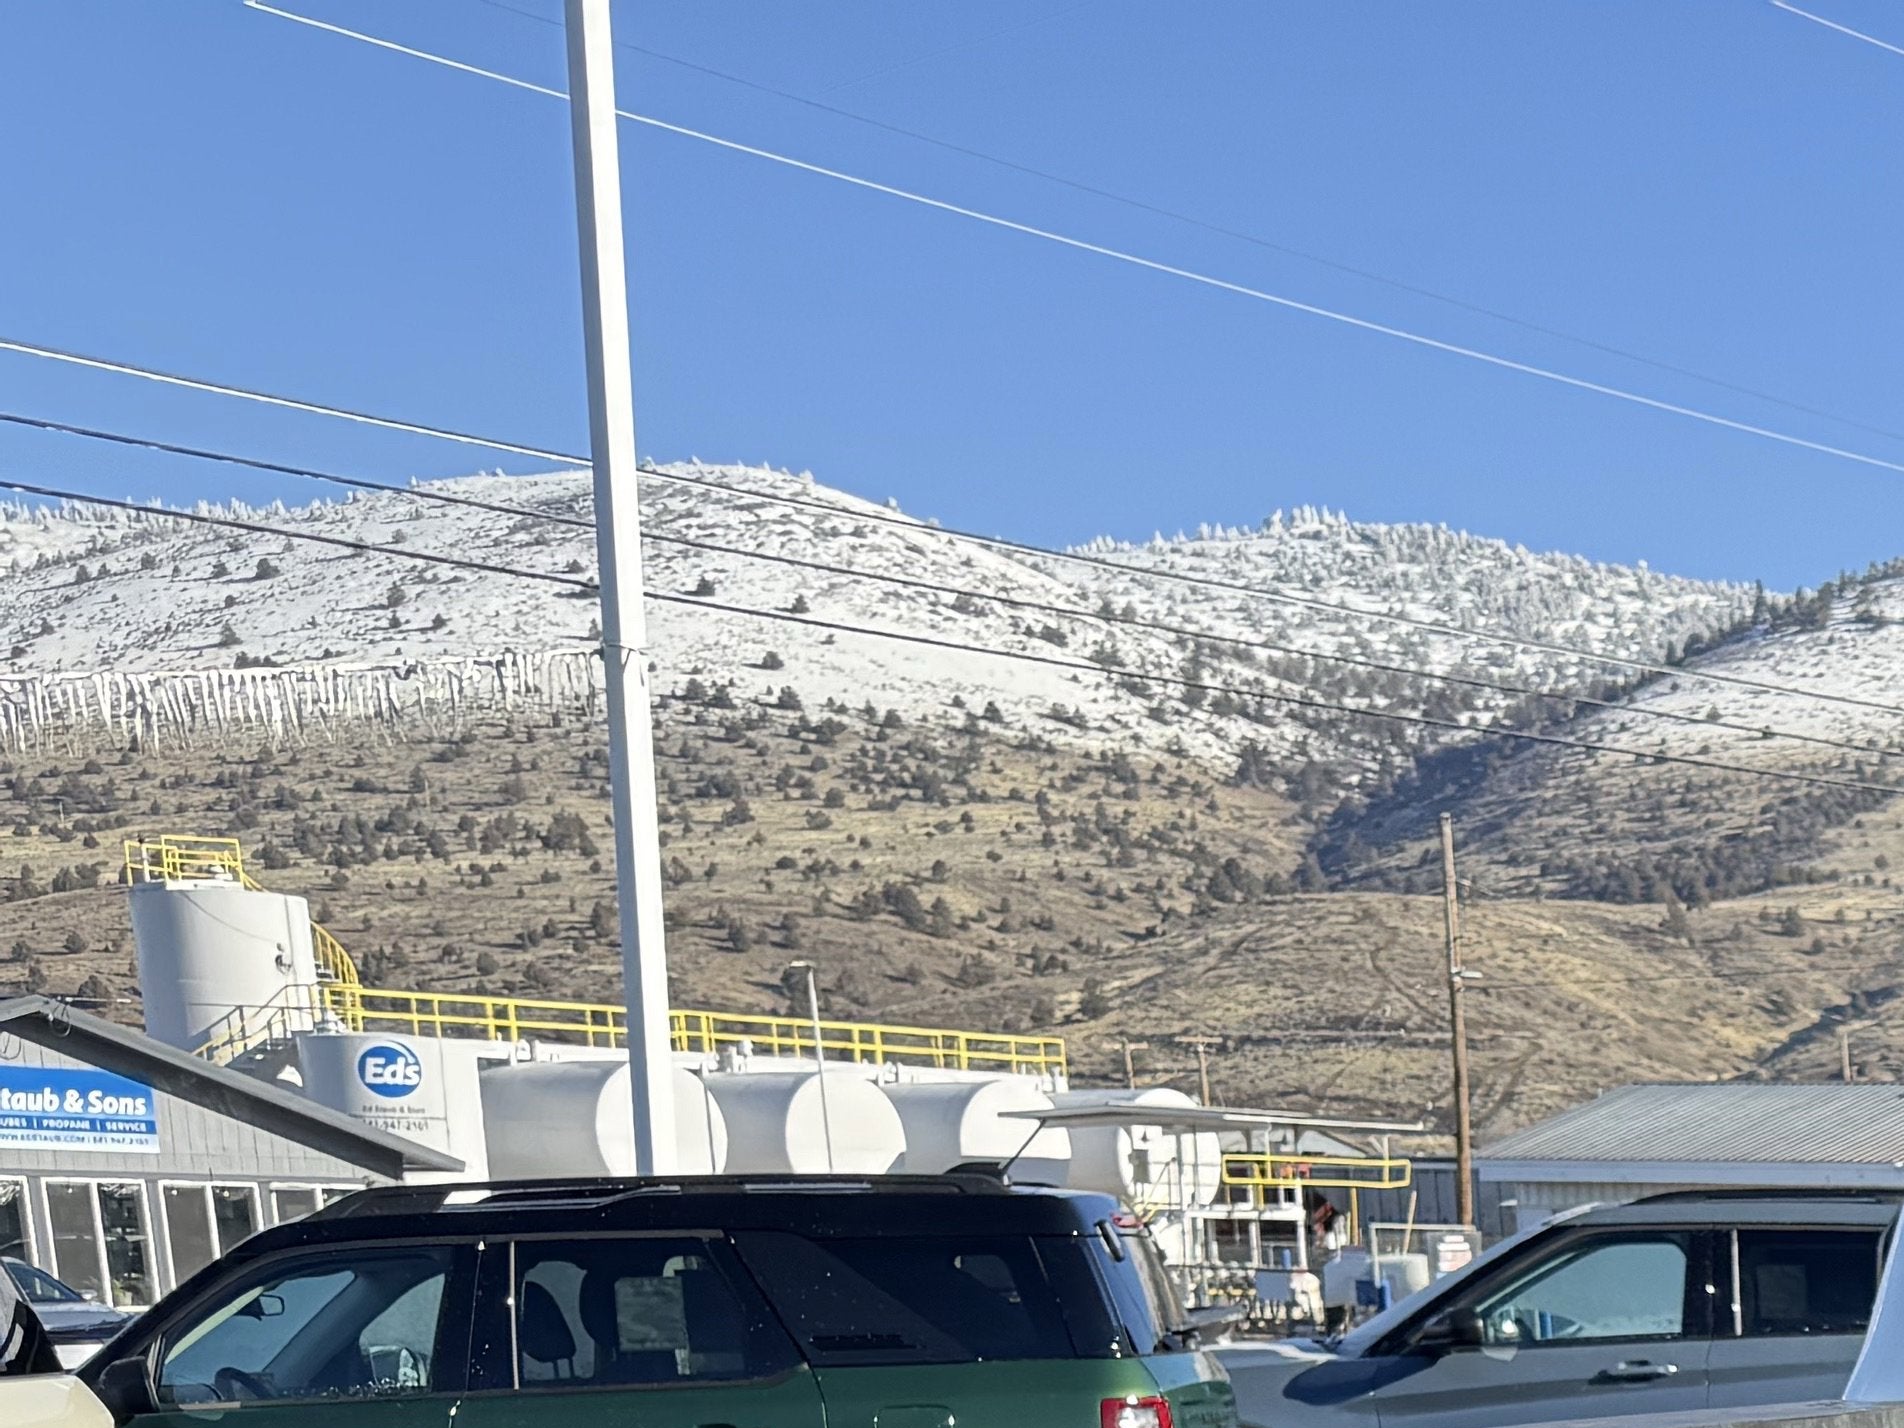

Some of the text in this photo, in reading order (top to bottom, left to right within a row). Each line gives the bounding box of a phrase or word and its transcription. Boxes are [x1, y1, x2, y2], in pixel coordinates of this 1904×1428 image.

[365, 1057, 421, 1086] Eds
[63, 1089, 84, 1114] &
[87, 1090, 147, 1117] Sons
[105, 1121, 147, 1133] SERVICE
